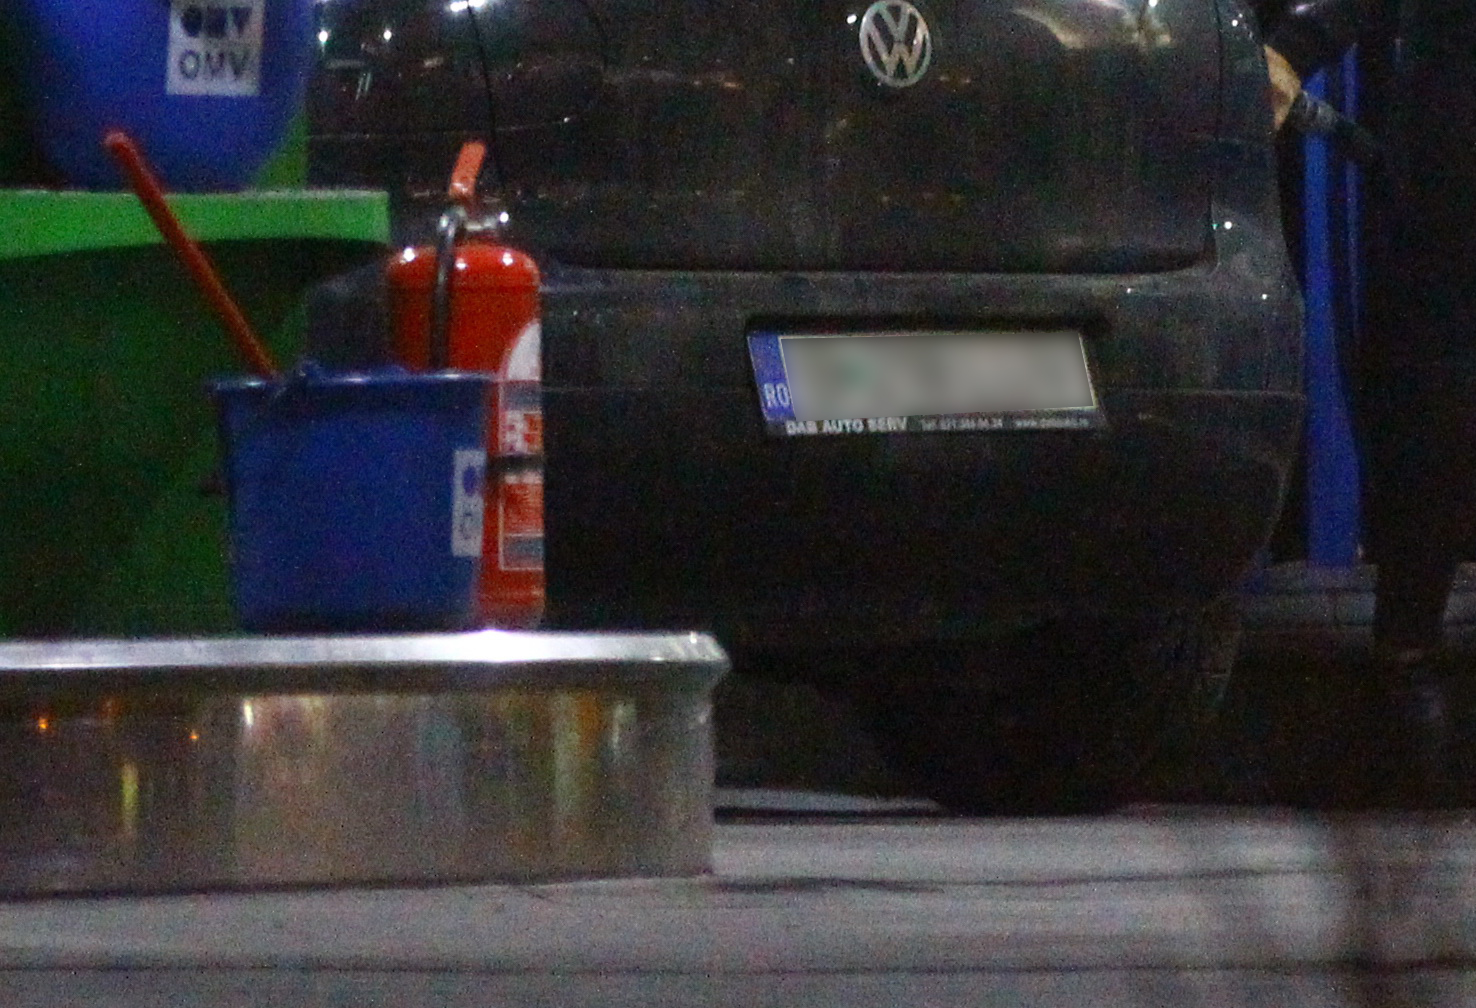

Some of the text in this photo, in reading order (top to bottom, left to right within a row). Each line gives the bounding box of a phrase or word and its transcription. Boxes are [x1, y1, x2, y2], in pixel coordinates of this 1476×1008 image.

[179, 49, 250, 80] OMV
[764, 383, 790, 408] RO
[822, 419, 865, 433] AUTO
